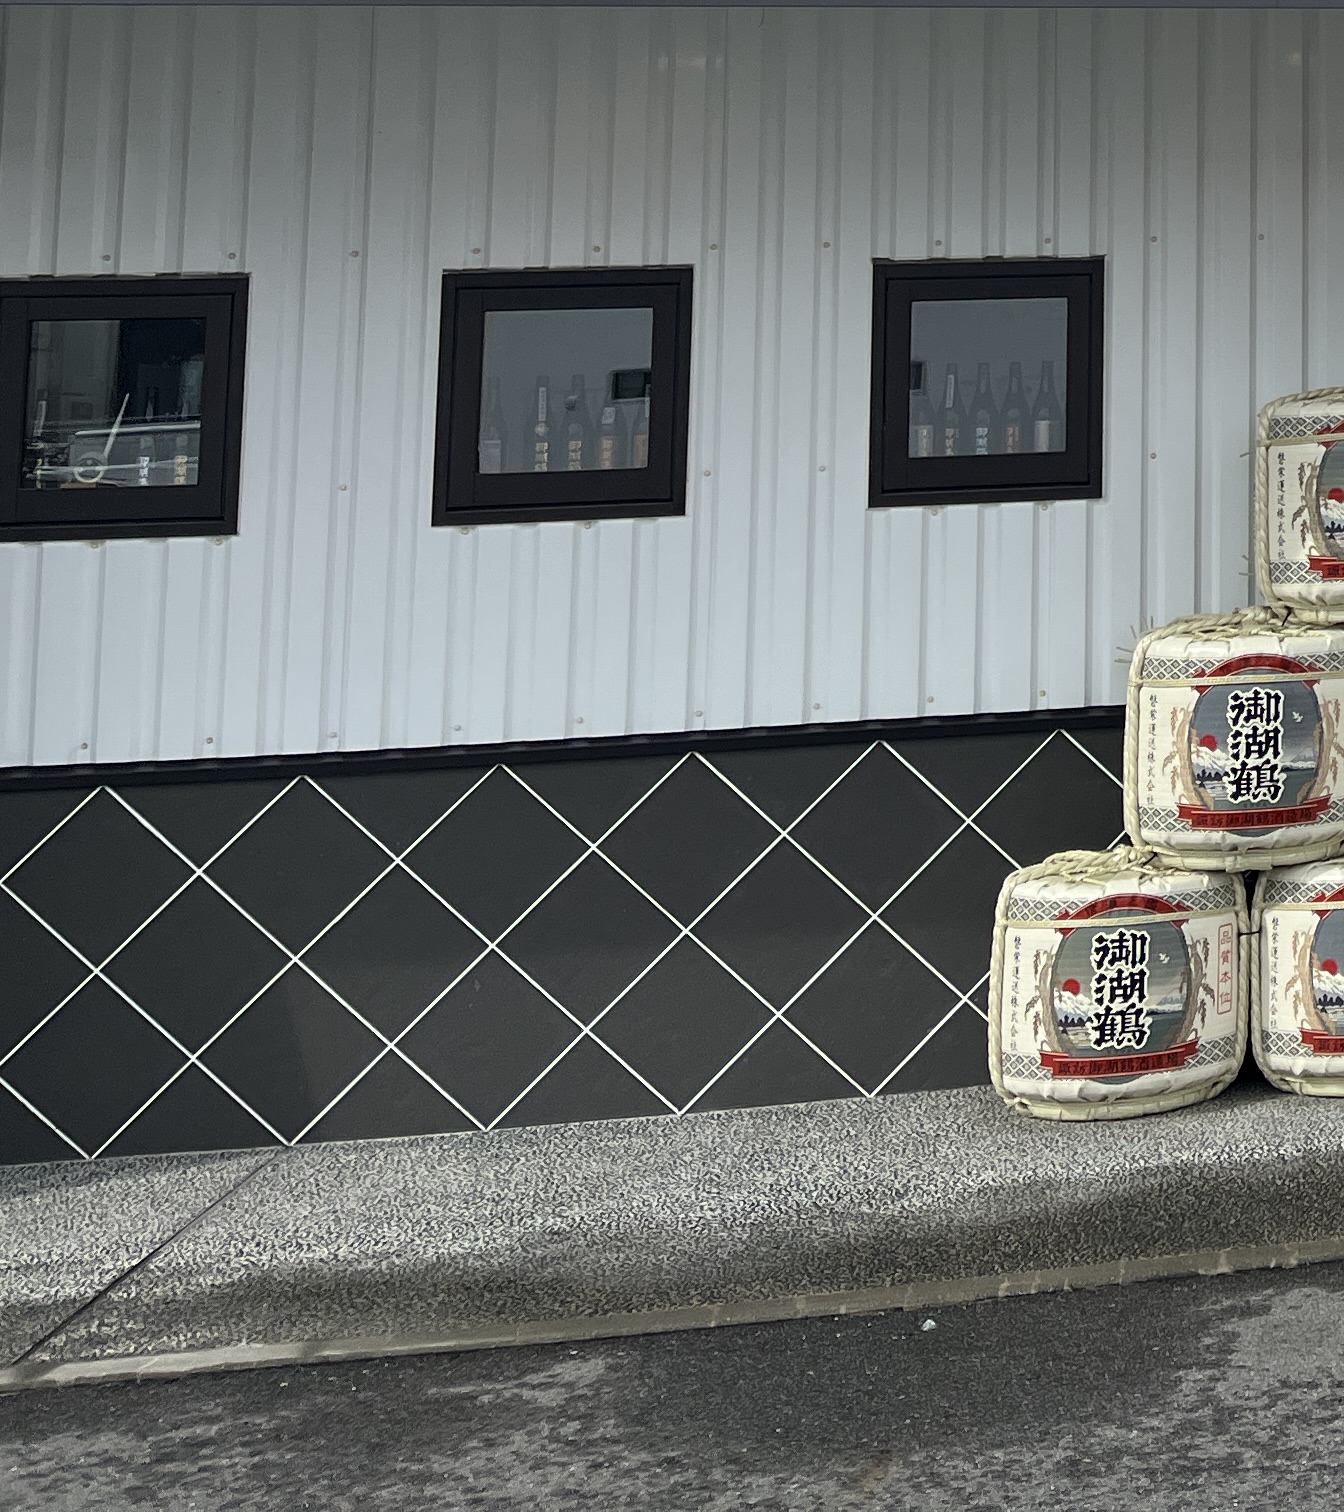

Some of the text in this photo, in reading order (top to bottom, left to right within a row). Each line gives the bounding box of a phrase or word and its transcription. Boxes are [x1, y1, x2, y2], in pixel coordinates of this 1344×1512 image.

[1229, 689, 1282, 801] 御湖鶴
[1093, 931, 1150, 1047] 御湖鶴
[1219, 931, 1231, 1006] 品質本位
